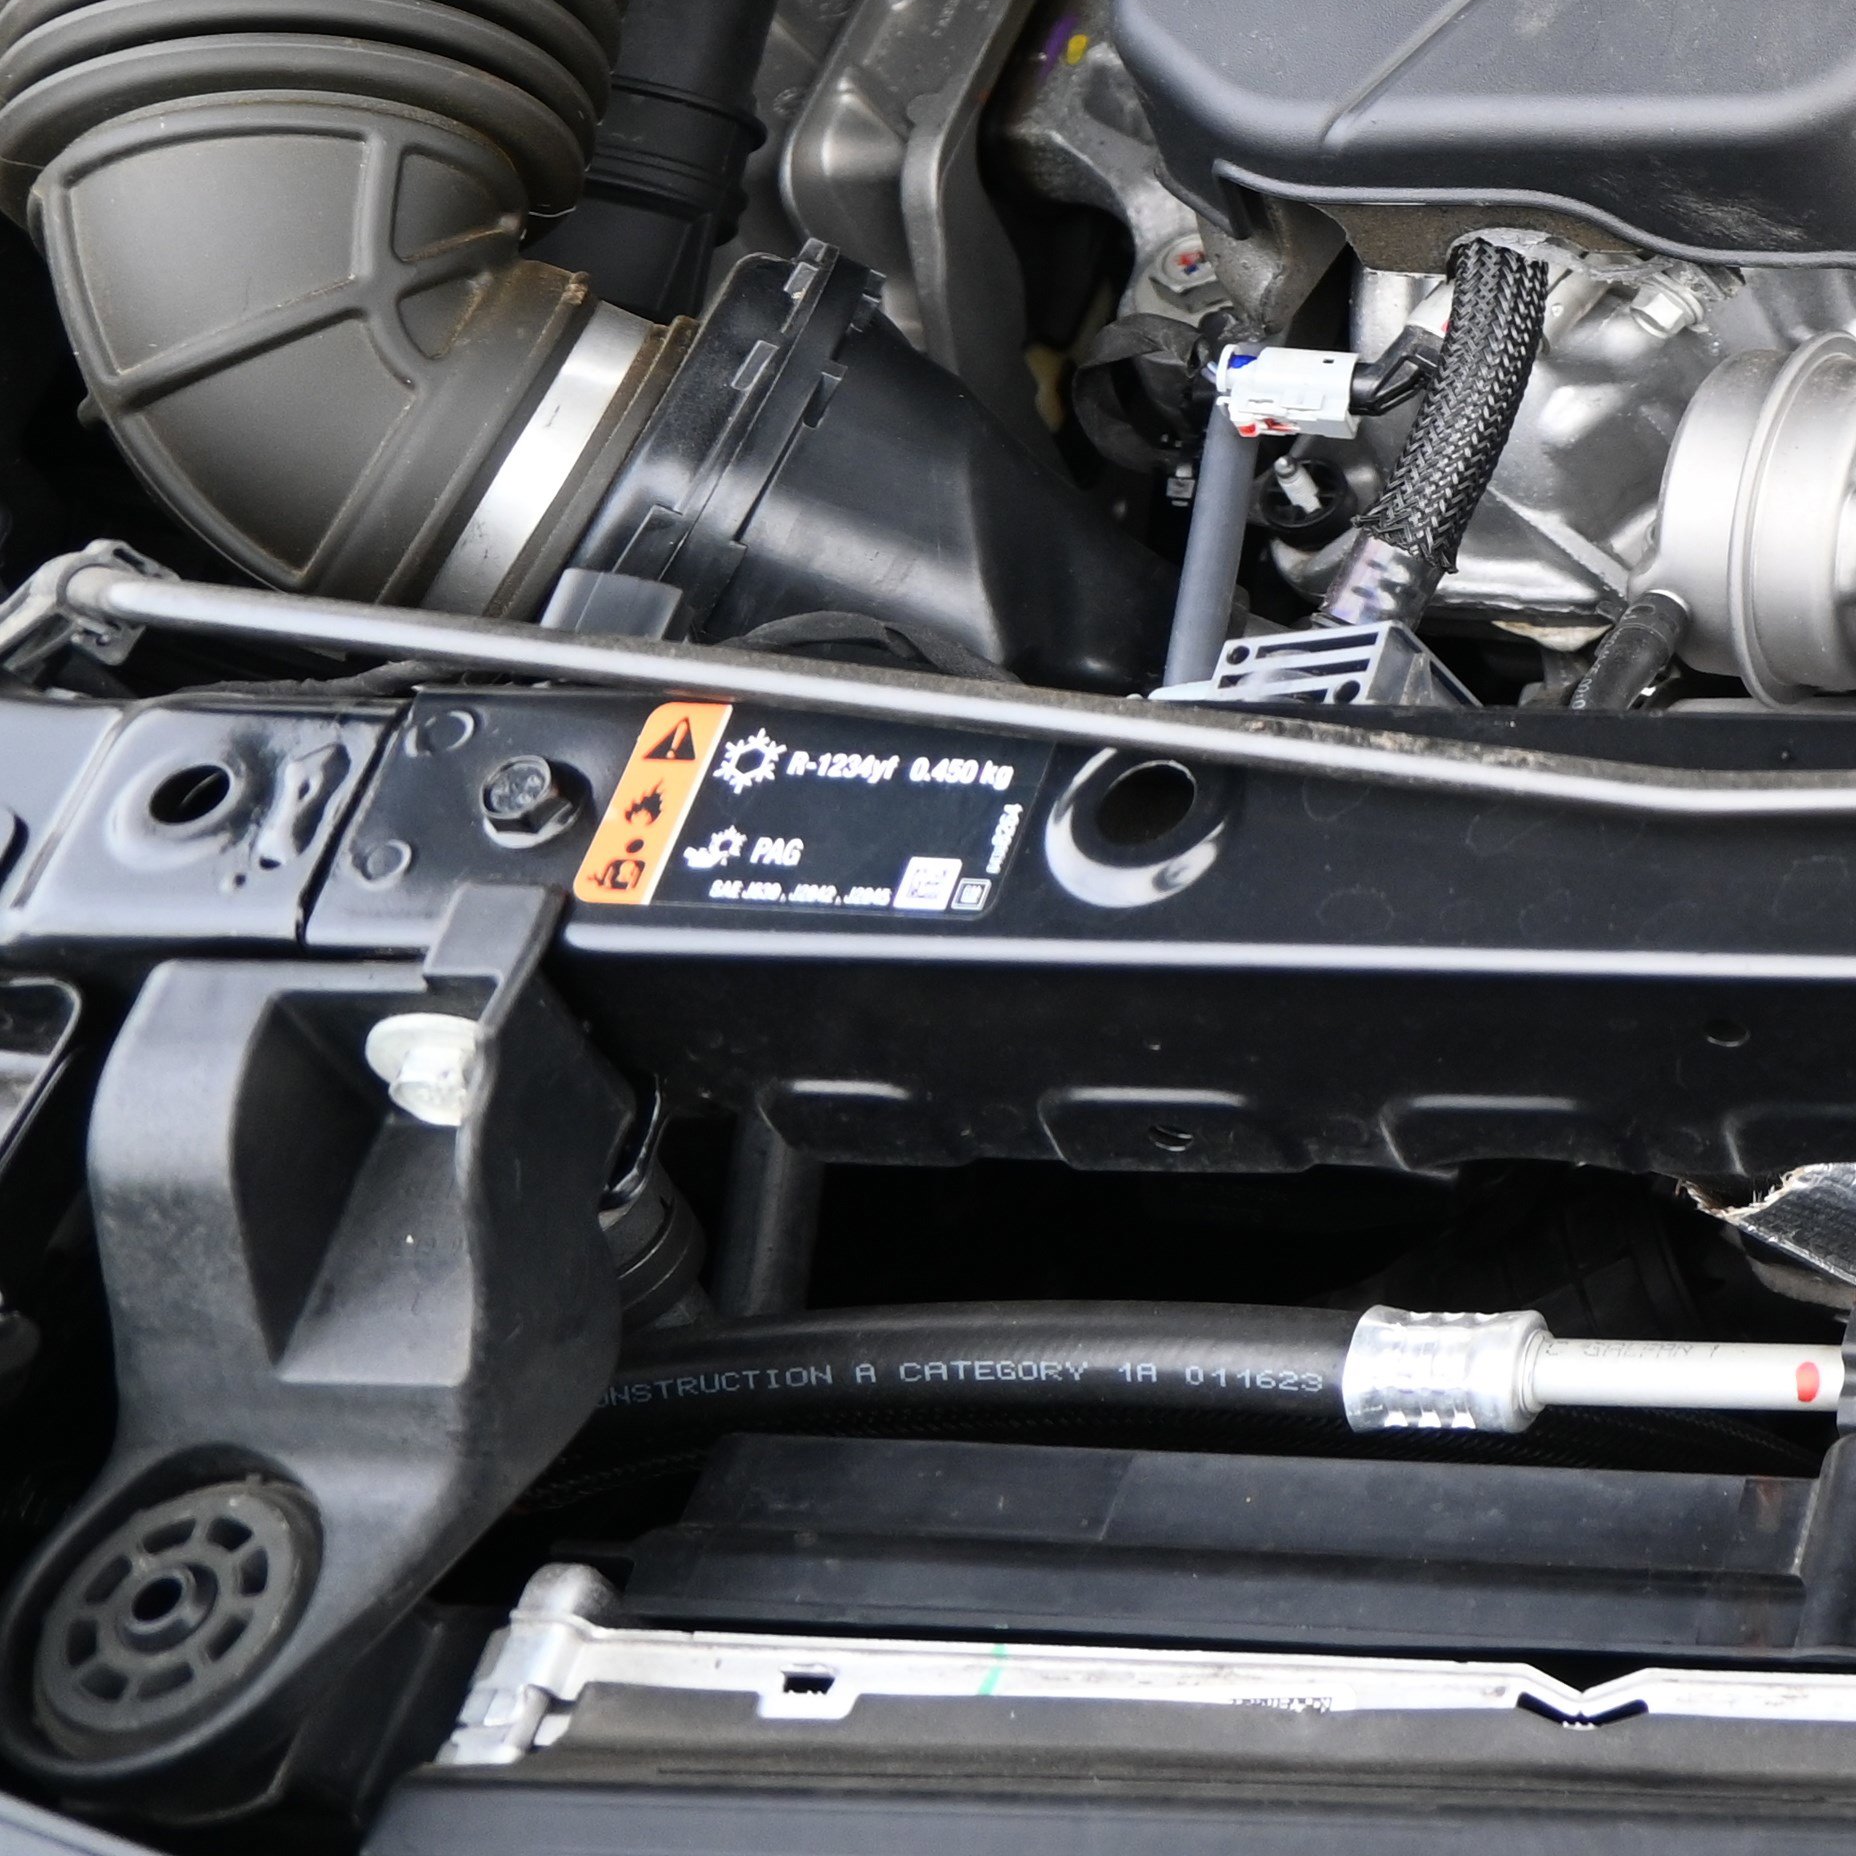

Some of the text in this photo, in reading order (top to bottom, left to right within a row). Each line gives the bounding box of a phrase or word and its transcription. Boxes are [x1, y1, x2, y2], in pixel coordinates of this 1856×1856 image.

[786, 751, 1015, 791] R-1234yf 0.450 kg
[750, 837, 805, 868] PAG
[855, 1363, 876, 1384] A
[899, 1360, 1089, 1384] CATEGORY
[1118, 1362, 1158, 1384] 1A
[1185, 1366, 1324, 1392] 011623
